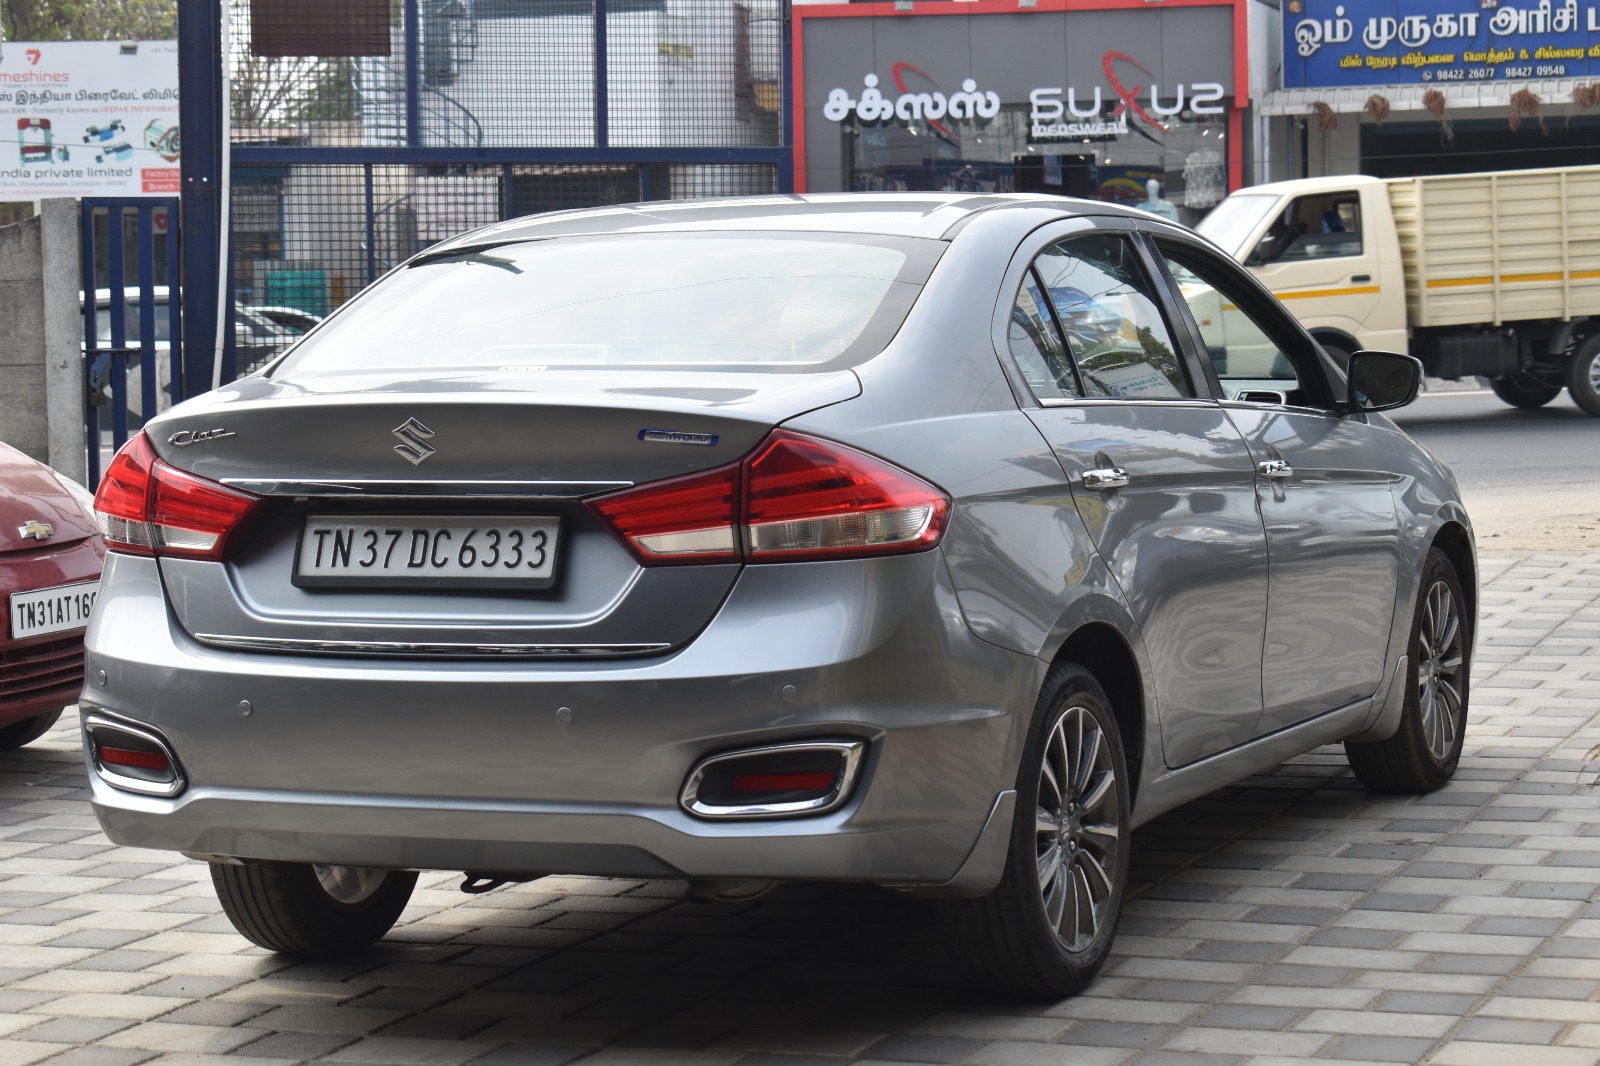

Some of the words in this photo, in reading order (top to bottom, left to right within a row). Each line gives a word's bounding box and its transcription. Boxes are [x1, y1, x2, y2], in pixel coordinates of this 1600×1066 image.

[1295, 5, 1353, 57] ஓம்
[1363, 13, 1479, 50] முருகா
[1489, 0, 1577, 36] அரிசி
[1340, 54, 1363, 68] மில்
[1401, 51, 1455, 68] விற்பனை
[1463, 47, 1515, 64] மொத்தம்
[1520, 49, 1529, 60] &
[0, 71, 70, 83] meshines
[1436, 69, 1464, 80] 98422
[1505, 67, 1532, 78] 98427
[1536, 65, 1565, 76] 09548
[16, 90, 72, 105] இந்தியா
[75, 88, 140, 103] பிரைவேட்
[823, 73, 1000, 122] சக்ஸஸ்
[35, 167, 84, 180] private
[87, 167, 133, 177] limited
[148, 183, 175, 191] Branch
[168, 428, 237, 447] Ciaz
